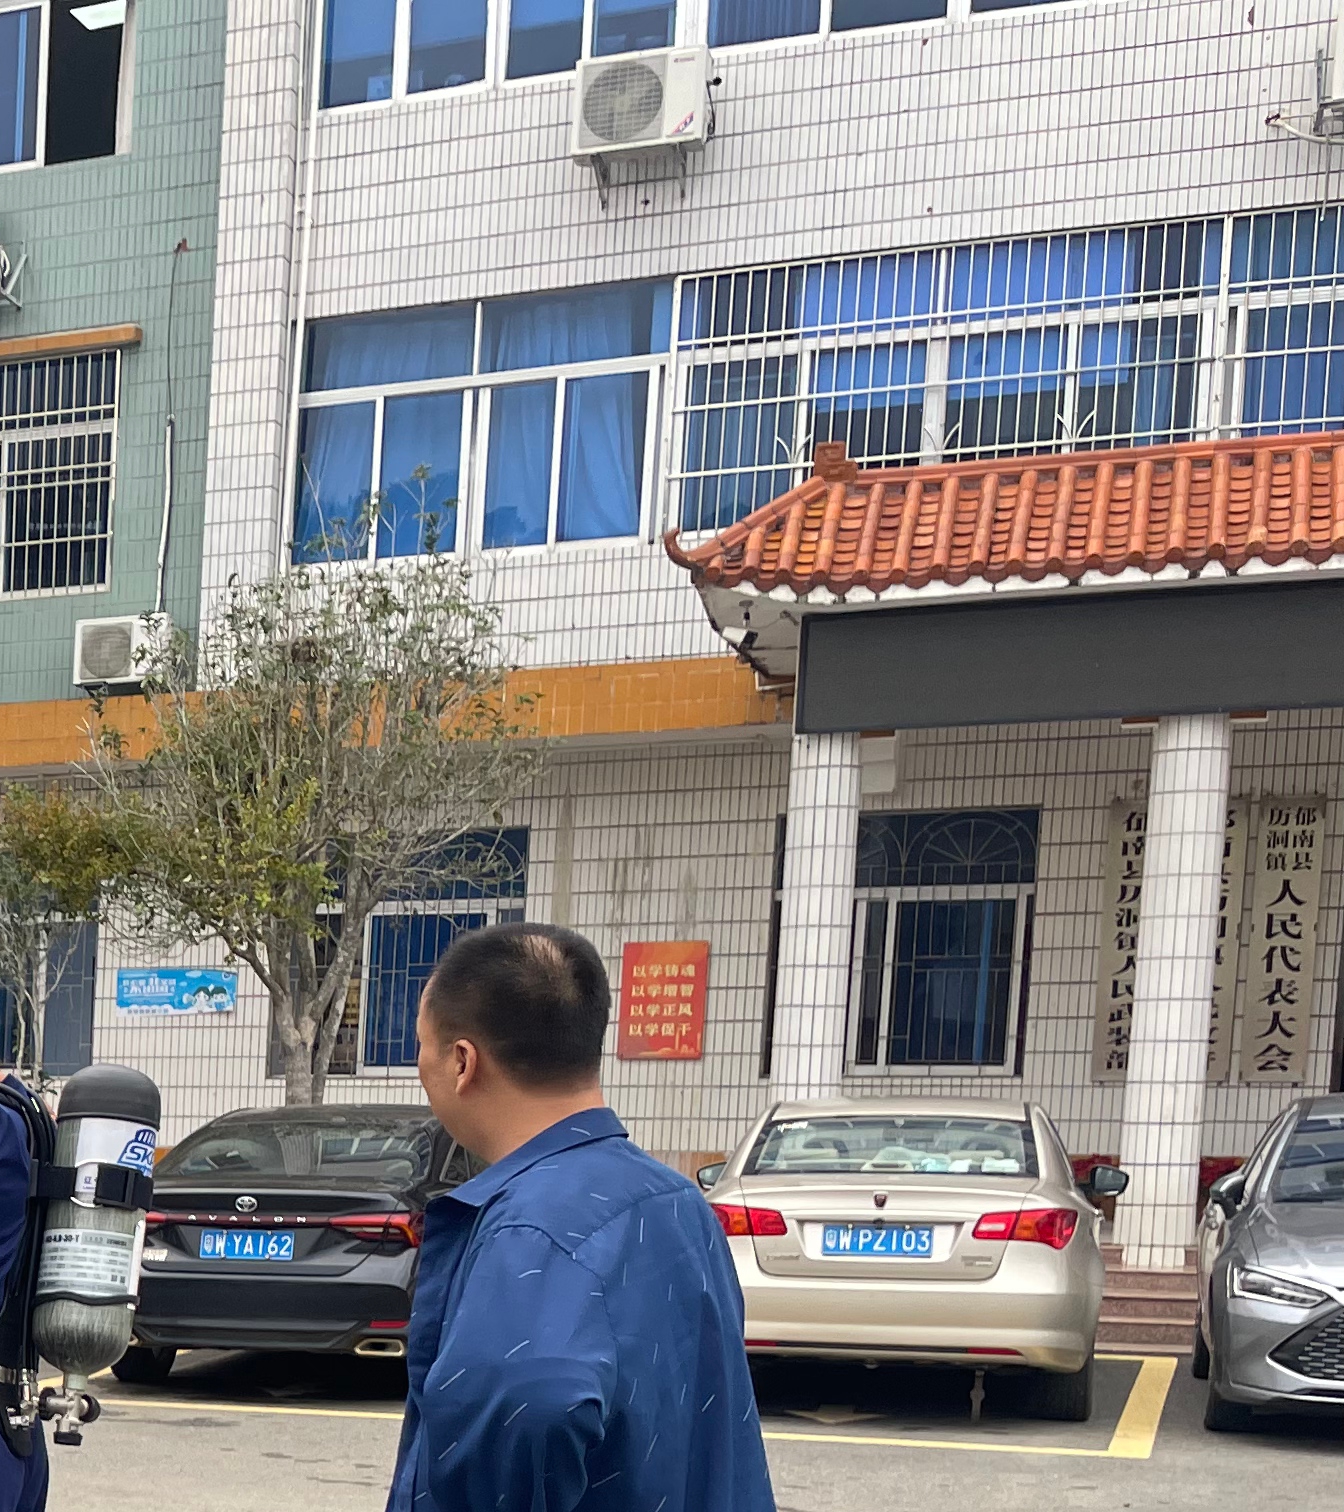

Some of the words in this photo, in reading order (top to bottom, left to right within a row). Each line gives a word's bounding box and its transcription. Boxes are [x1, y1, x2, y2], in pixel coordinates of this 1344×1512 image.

[1265, 806, 1291, 872] 历洞镇
[1292, 805, 1316, 871] 郁南县
[1253, 878, 1308, 1073] 人民代表大会
[187, 1213, 307, 1223] AVALON
